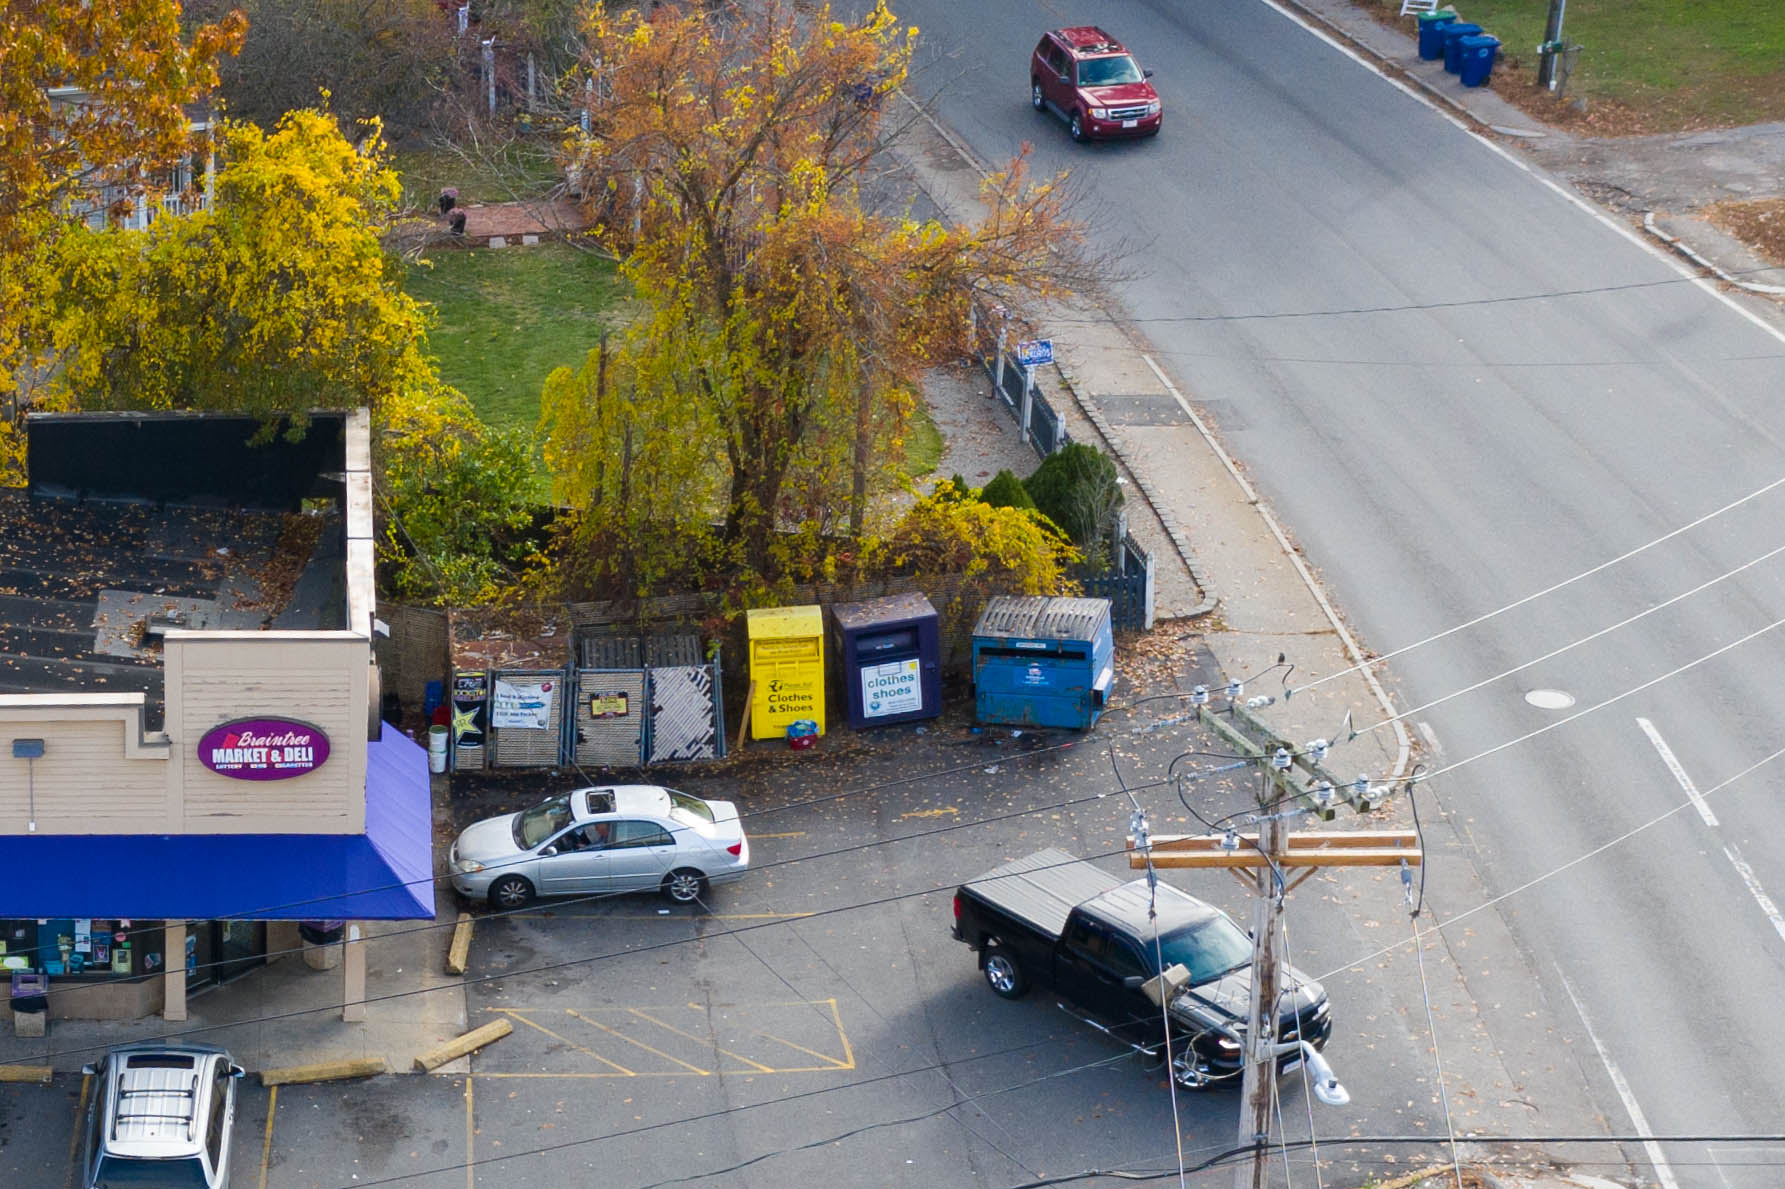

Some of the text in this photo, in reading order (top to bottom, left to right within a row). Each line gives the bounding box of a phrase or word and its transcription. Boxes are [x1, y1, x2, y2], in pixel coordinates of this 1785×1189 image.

[867, 673, 915, 688] clothes
[768, 693, 814, 703] Clothes
[872, 686, 912, 699] shoes
[779, 703, 814, 713] Shoes
[237, 731, 311, 747] Braintree
[212, 747, 314, 763] MARKET & DELI
